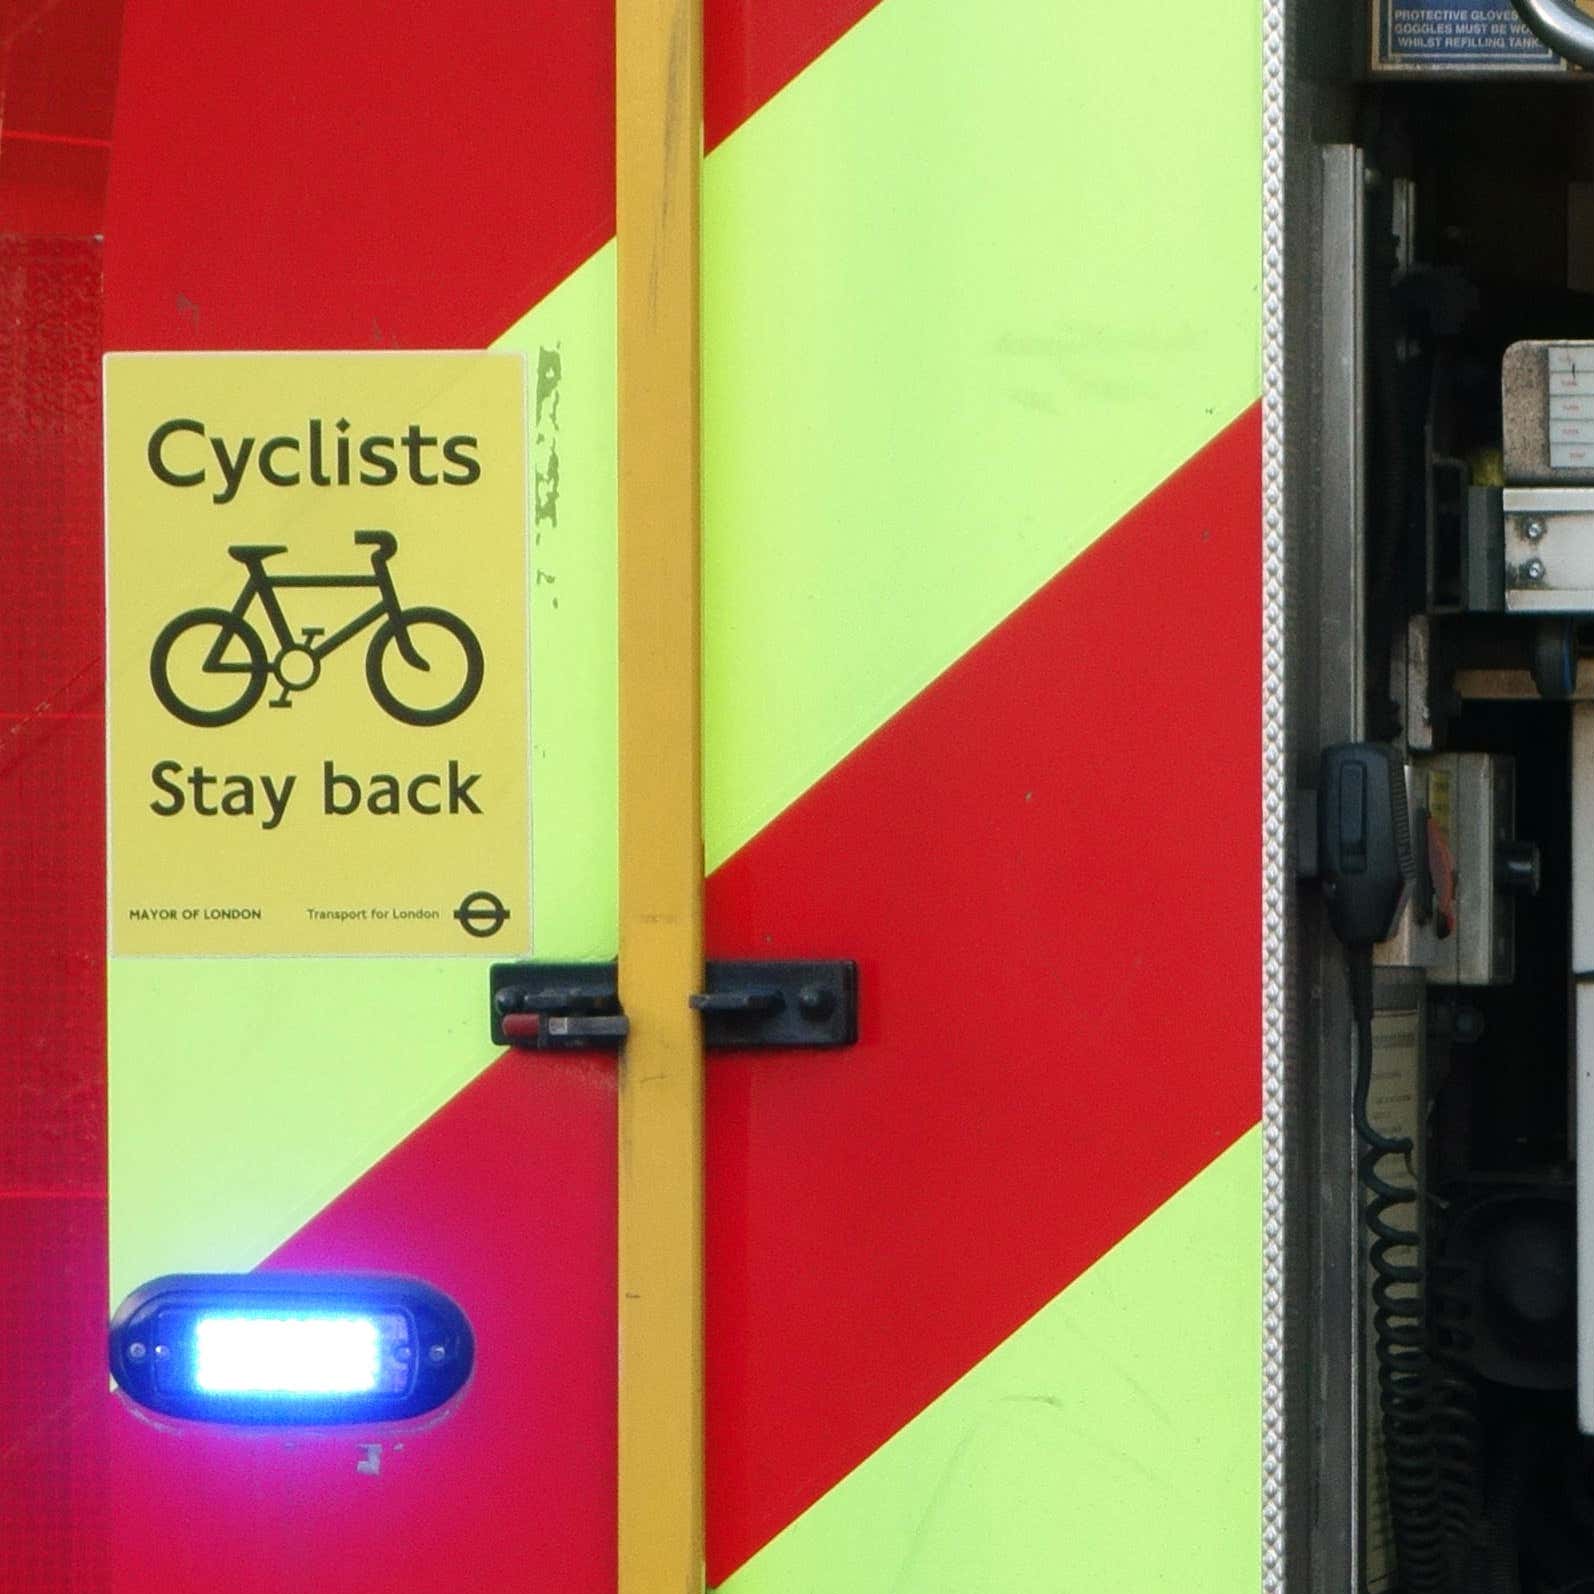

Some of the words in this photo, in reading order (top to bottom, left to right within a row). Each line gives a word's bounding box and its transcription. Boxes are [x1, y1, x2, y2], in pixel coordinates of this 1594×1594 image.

[1394, 9, 1467, 20] PROTECTIVE
[1395, 23, 1451, 34] GOGGLES
[1455, 23, 1487, 34] MUST
[1491, 23, 1506, 34] BE
[1398, 37, 1441, 48] WHILST
[1445, 37, 1505, 48] REFILLING
[147, 418, 482, 505] Cyclists
[149, 760, 297, 830] Stay
[323, 760, 484, 816] back
[129, 909, 178, 921] MAYOR
[182, 909, 200, 920] OF
[204, 909, 262, 920] LONDON
[307, 908, 367, 923] Transport
[371, 908, 389, 920] for
[393, 908, 440, 920] London
